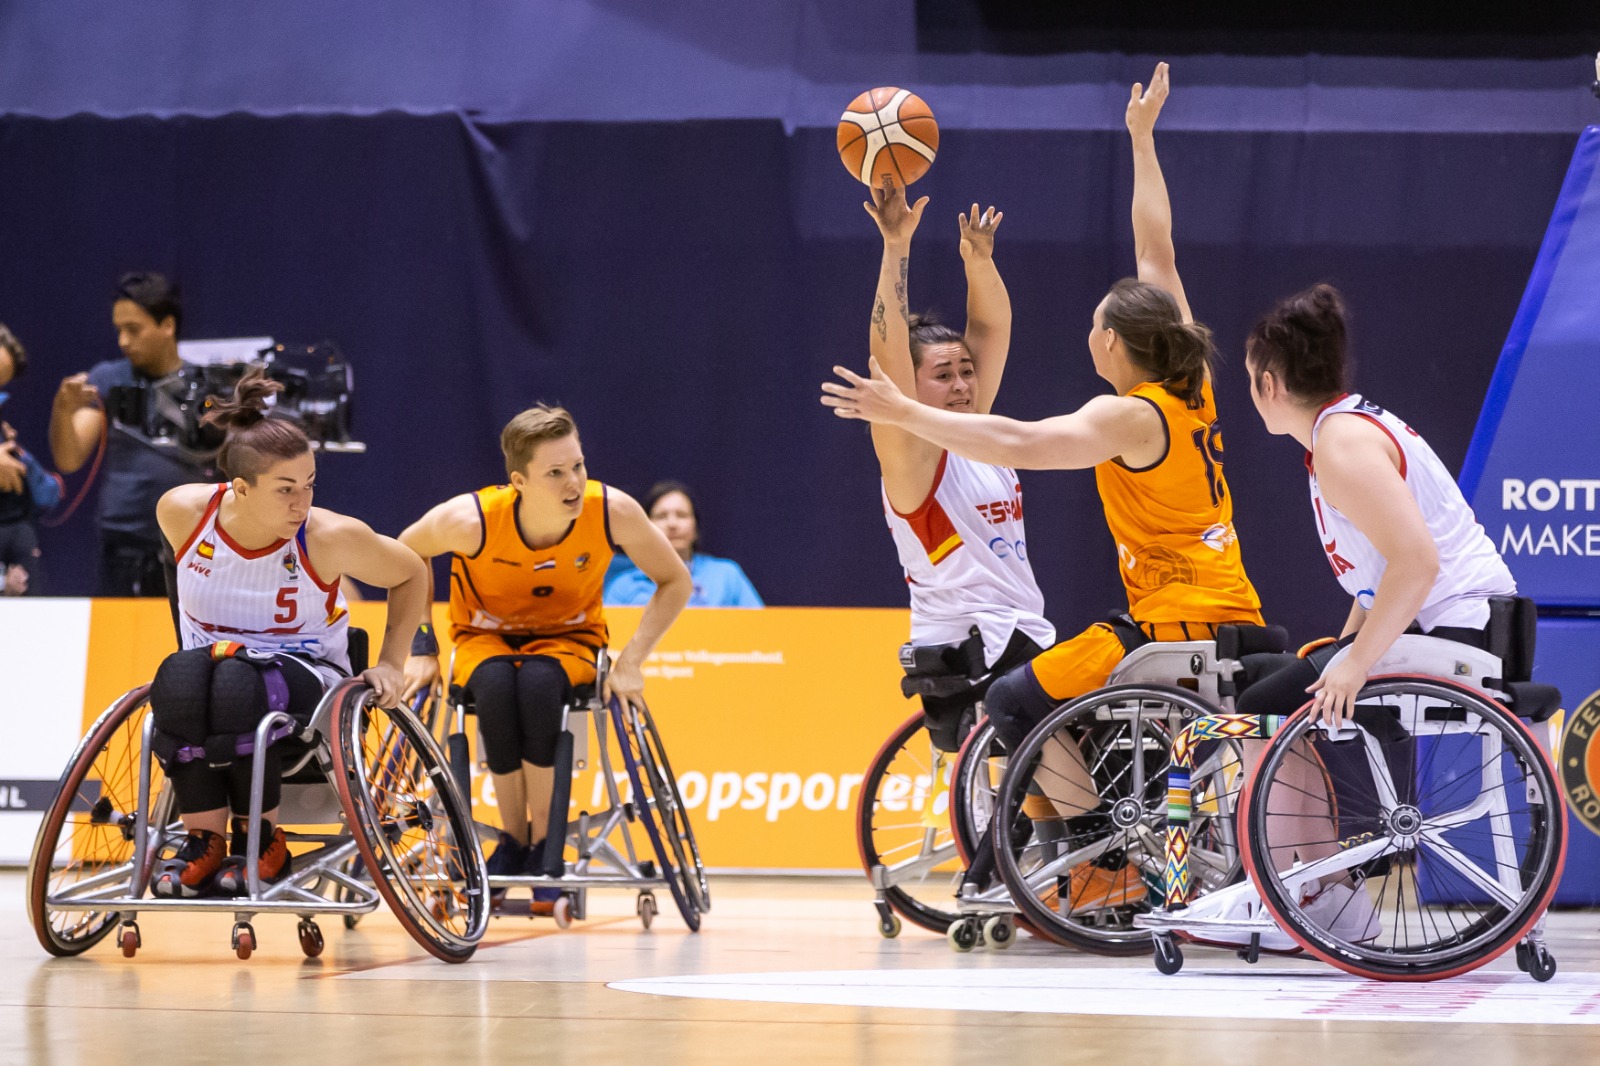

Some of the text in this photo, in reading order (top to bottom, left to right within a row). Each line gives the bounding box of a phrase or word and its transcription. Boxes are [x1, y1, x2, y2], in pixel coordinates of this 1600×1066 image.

[1502, 478, 1600, 511] ROTT
[1501, 523, 1600, 556] MAKE
[274, 586, 299, 624] 5
[1572, 697, 1600, 740] FE
